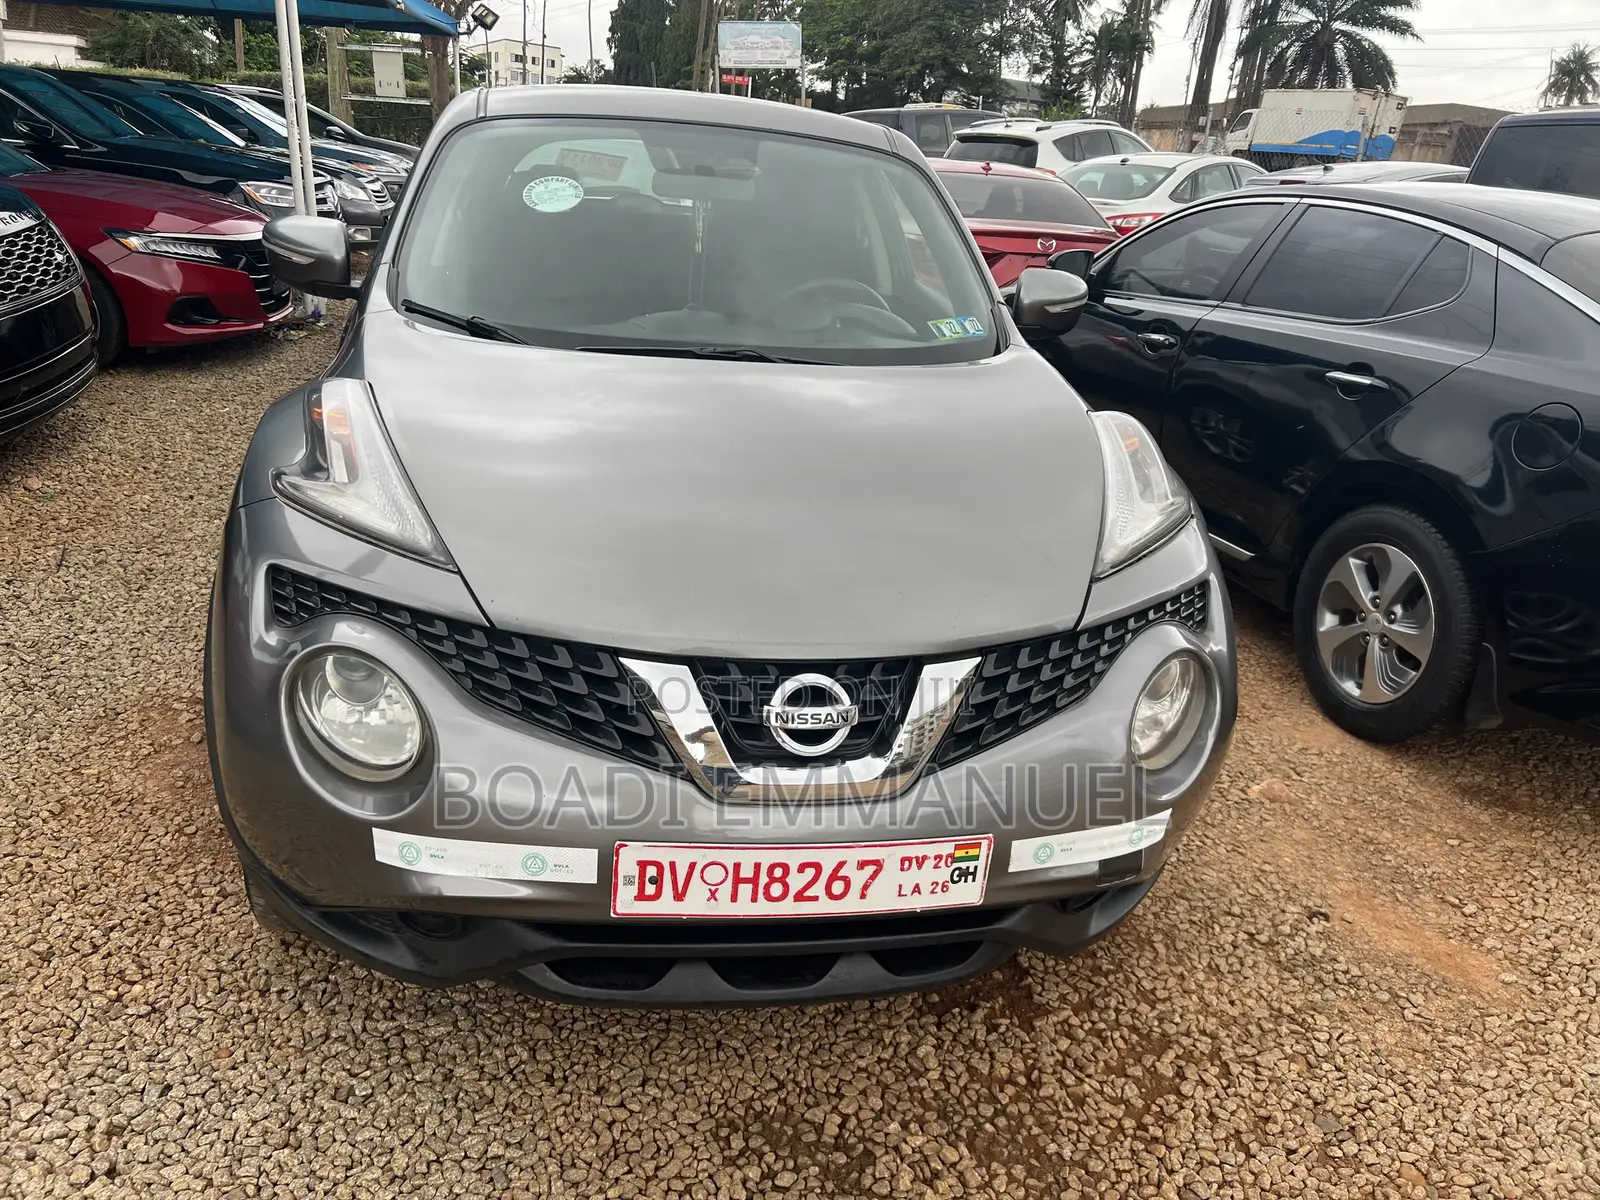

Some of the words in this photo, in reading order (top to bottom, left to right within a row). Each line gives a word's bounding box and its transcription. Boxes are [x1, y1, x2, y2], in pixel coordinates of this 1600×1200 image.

[533, 177, 569, 187] COMPANY
[774, 711, 850, 726] NISSAN
[900, 854, 930, 872] DV
[633, 859, 698, 902] DV
[729, 857, 885, 903] H8267
[949, 865, 979, 885] GH
[897, 882, 922, 897] LA
[930, 880, 950, 894] 26
